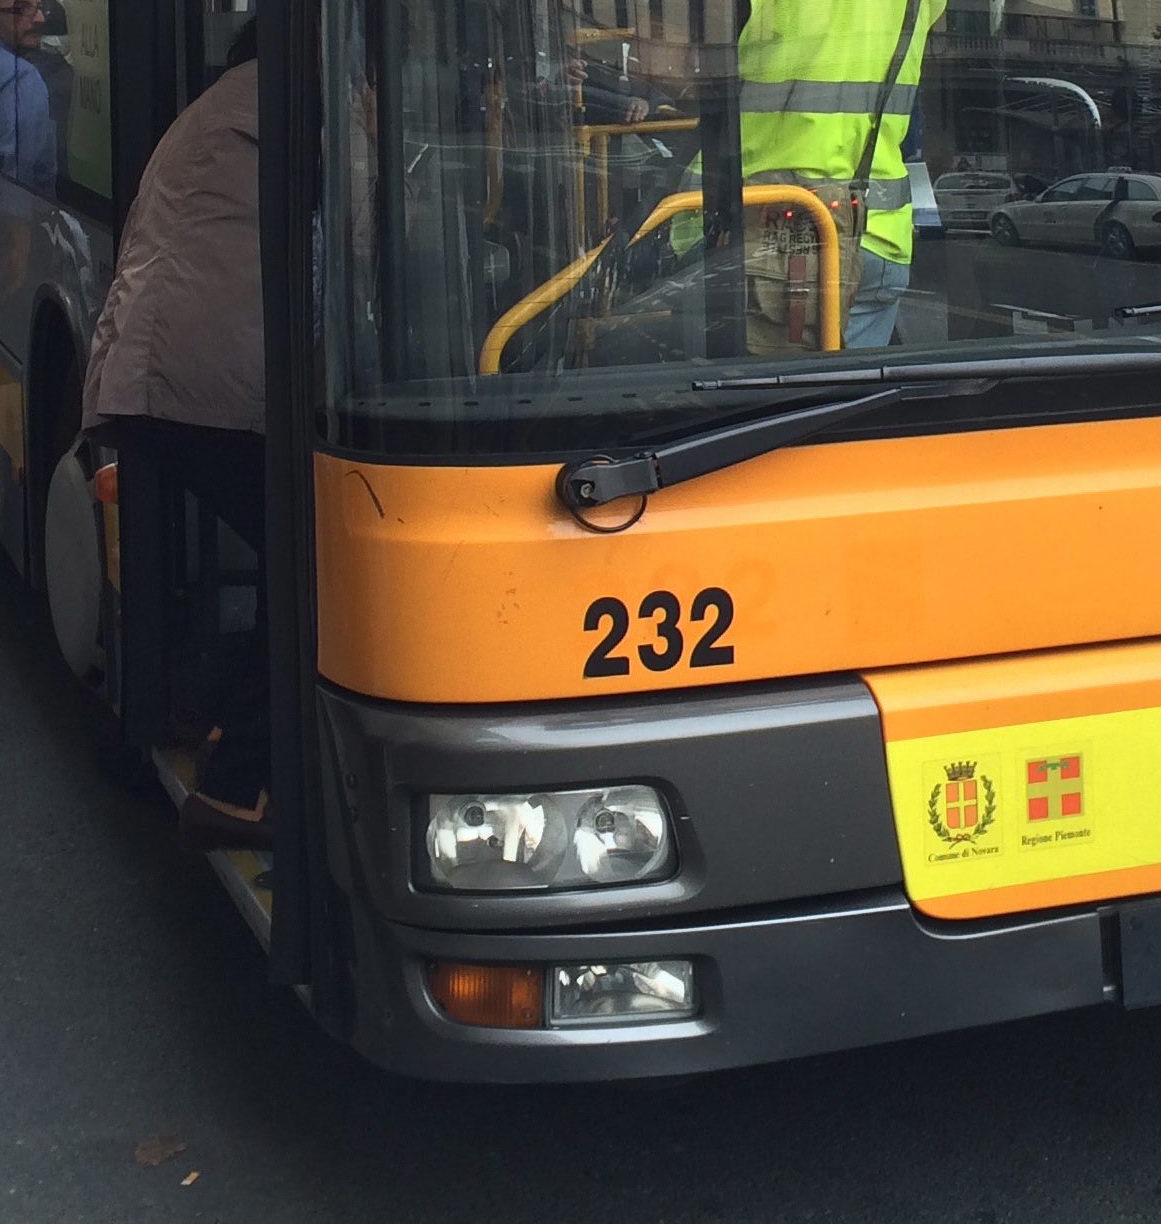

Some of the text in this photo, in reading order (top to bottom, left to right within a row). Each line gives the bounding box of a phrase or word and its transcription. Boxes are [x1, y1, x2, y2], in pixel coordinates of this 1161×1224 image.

[582, 587, 735, 679] 232
[1021, 829, 1092, 847] Regione Piemonte
[928, 846, 1000, 863] Comune di Novara
